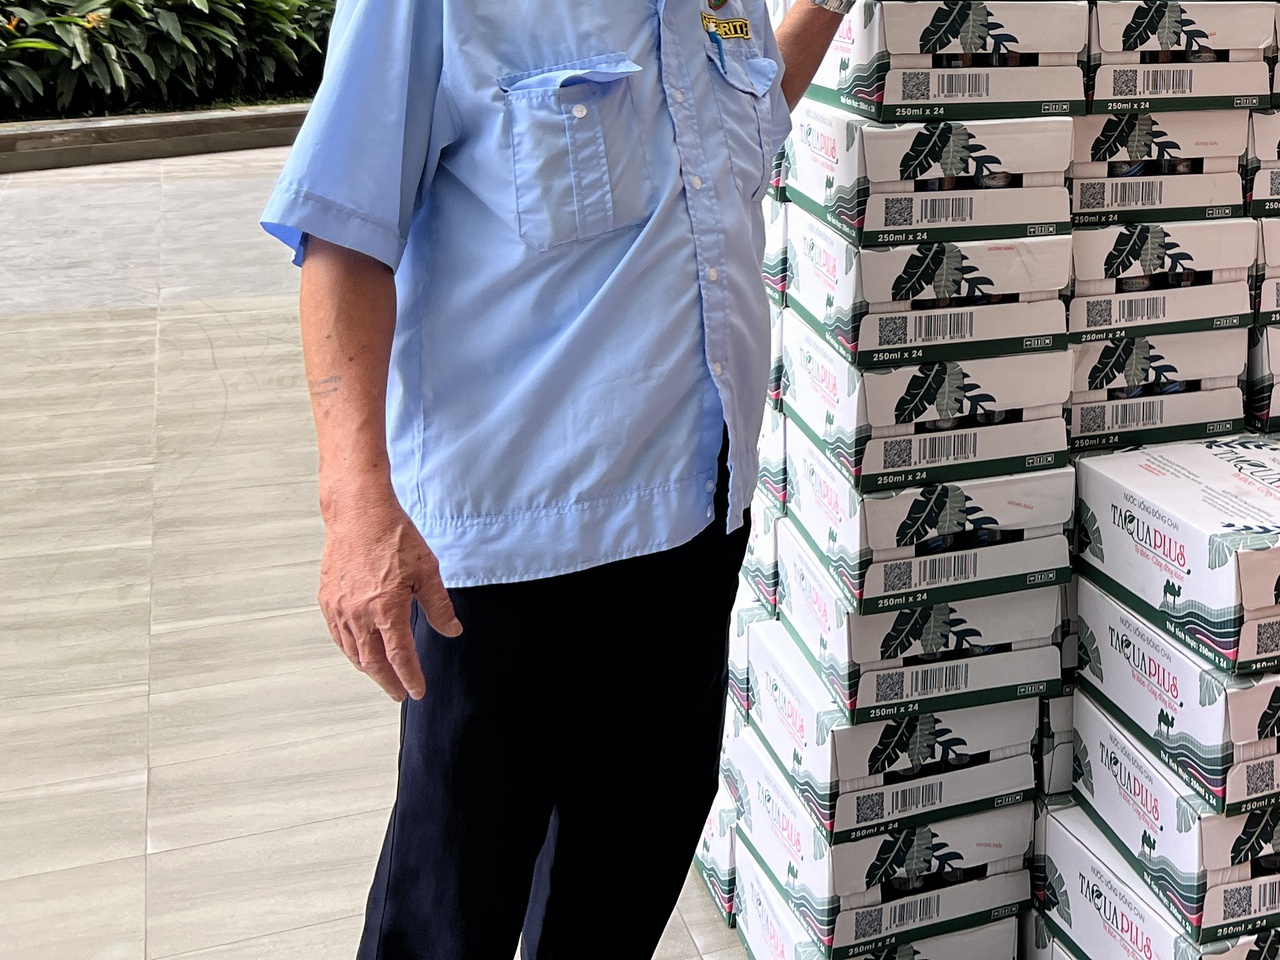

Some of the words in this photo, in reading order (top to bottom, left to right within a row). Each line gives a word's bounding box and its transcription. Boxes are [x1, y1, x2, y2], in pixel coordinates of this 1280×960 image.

[1111, 503, 1186, 568] TAQUAPLUS
[878, 596, 906, 608] 250ml
[916, 592, 928, 600] 24
[1240, 798, 1268, 812] 250ml
